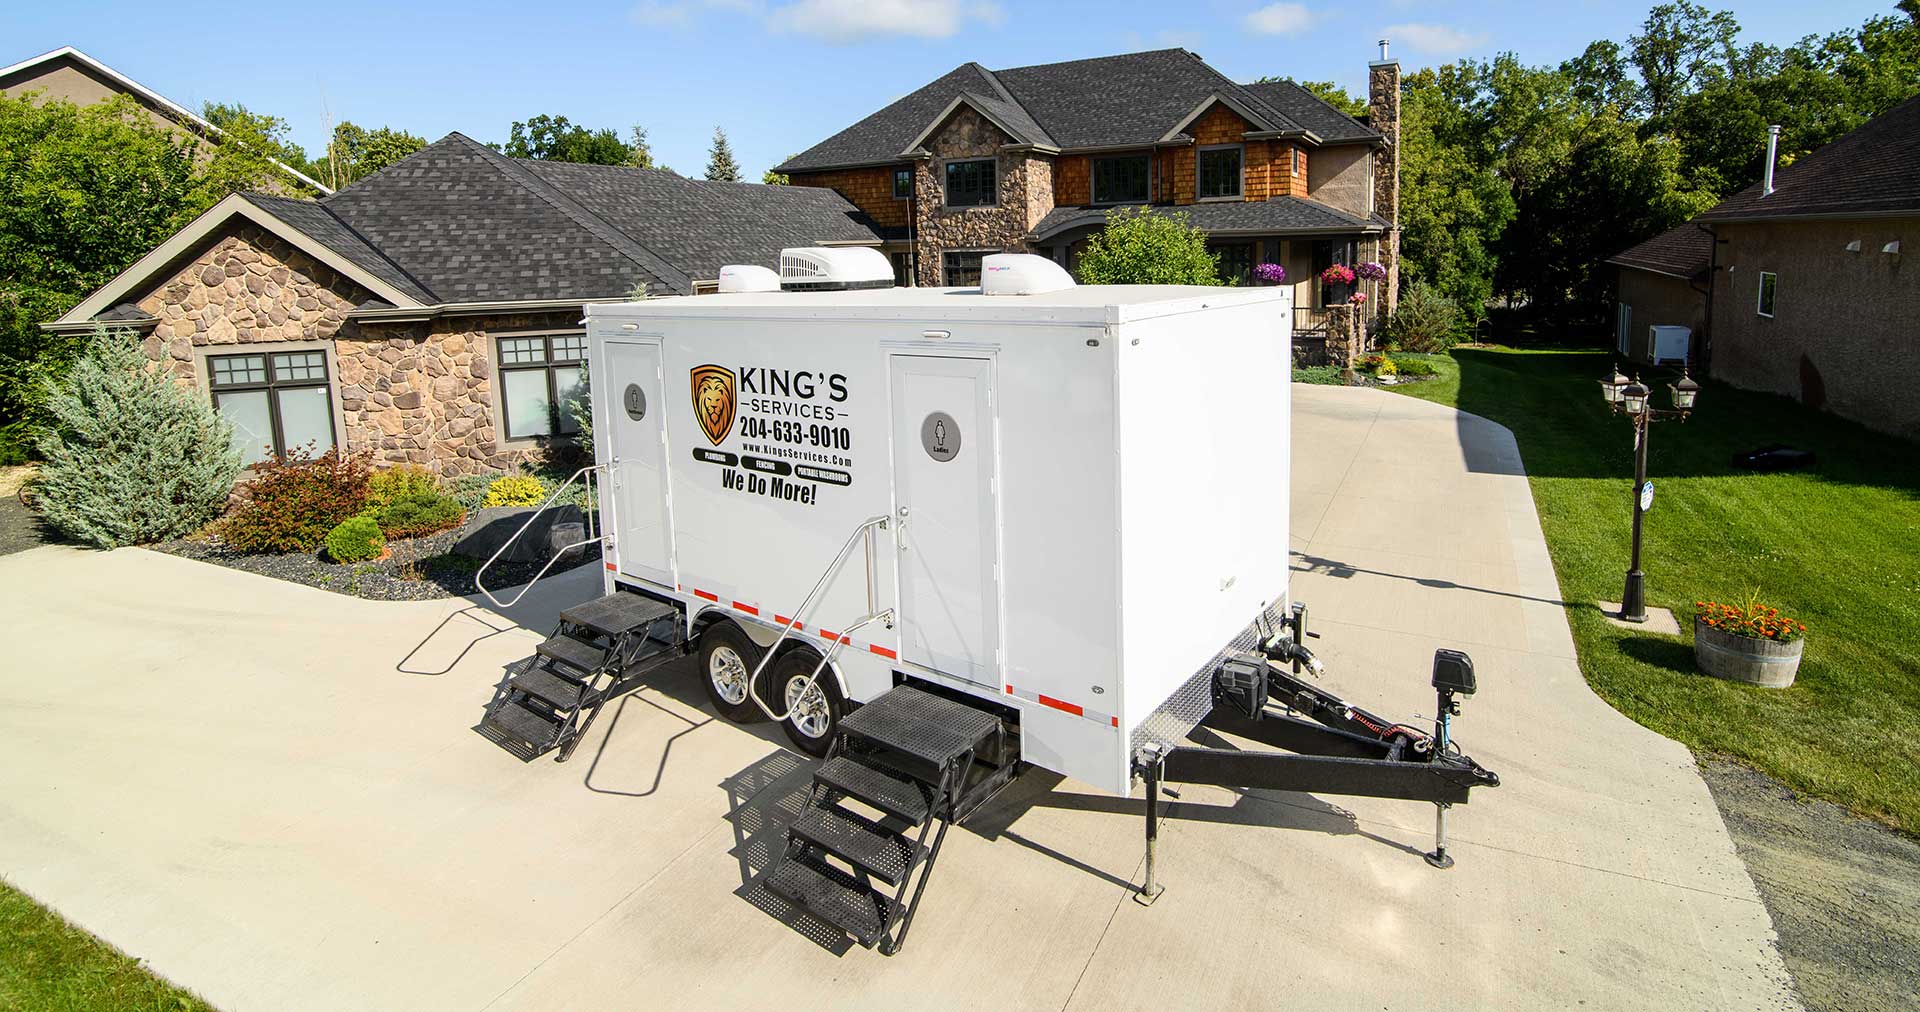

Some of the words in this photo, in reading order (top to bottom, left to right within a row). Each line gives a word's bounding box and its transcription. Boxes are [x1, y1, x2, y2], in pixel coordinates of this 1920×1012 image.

[739, 366, 849, 402] KING'S
[751, 398, 835, 421] SERVICES
[740, 416, 851, 450] 204-633-9010
[742, 442, 852, 467] www.KingsServices.Com
[722, 468, 744, 491] We
[747, 473, 767, 496] Do
[770, 477, 817, 505] More!
